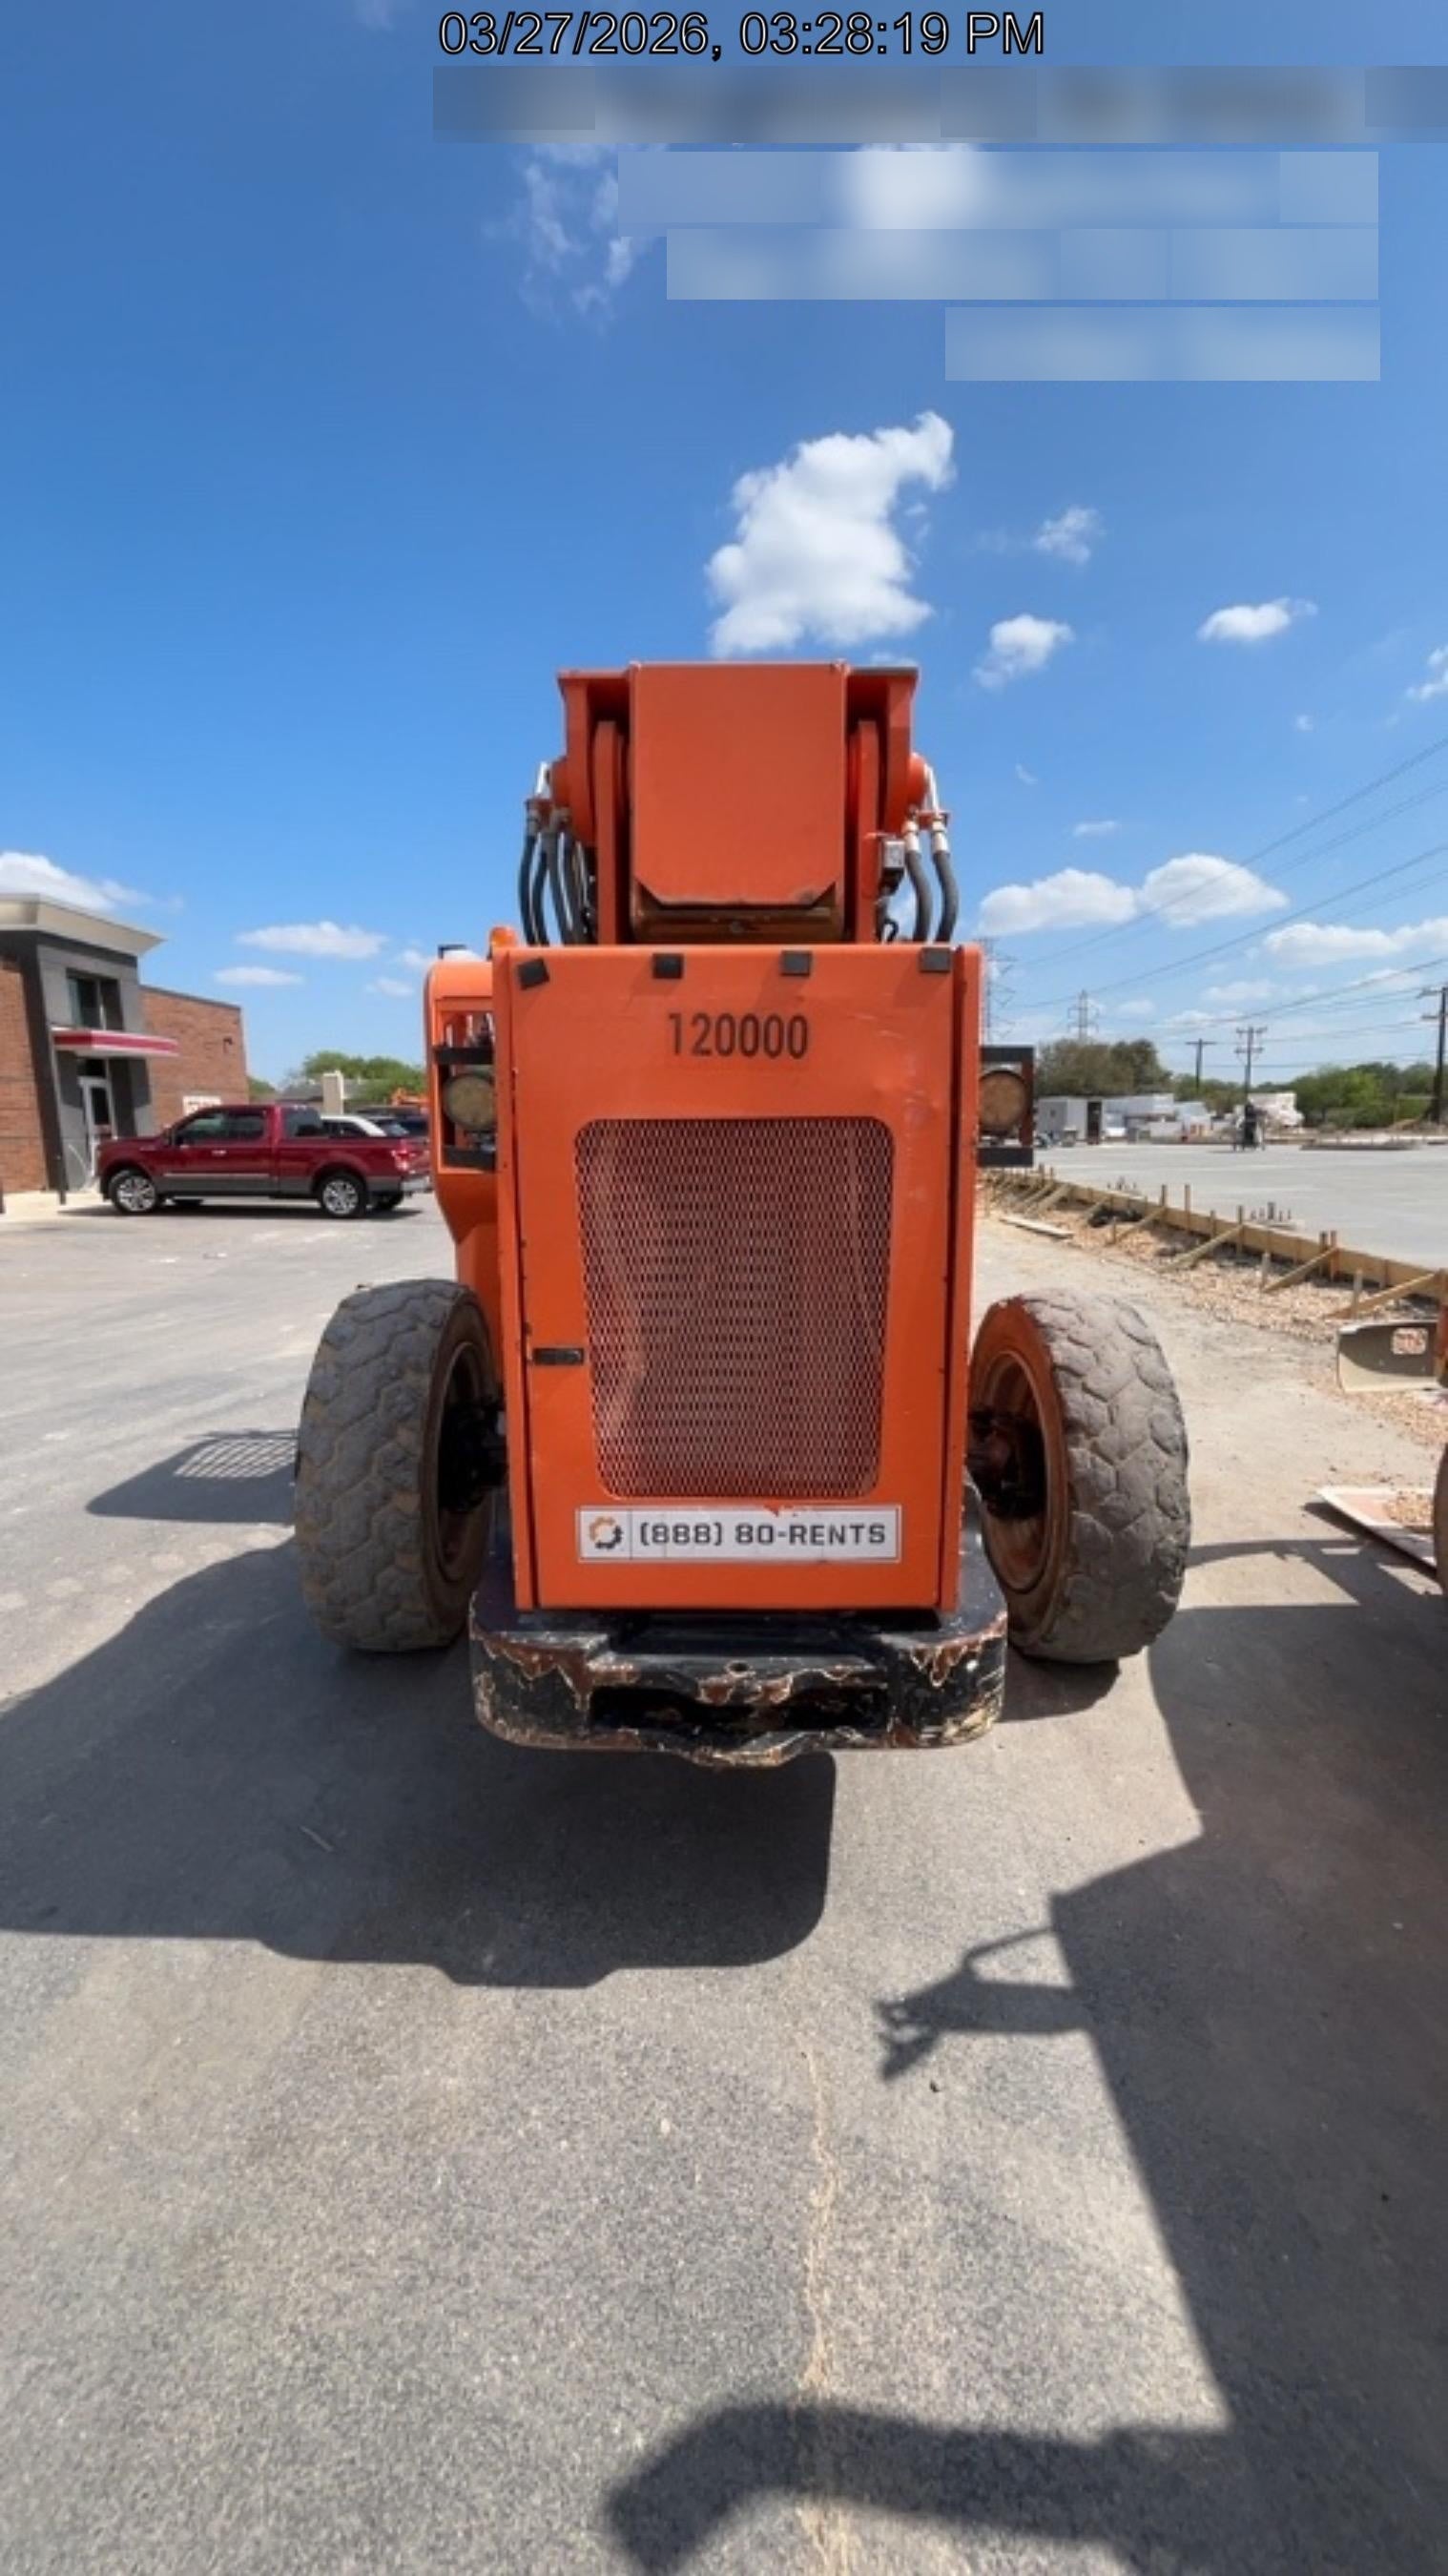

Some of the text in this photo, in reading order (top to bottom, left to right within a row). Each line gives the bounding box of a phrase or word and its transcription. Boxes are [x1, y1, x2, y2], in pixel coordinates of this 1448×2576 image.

[669, 1012, 809, 1059] 120000
[639, 1522, 886, 1547] (888) 80-RENTS
